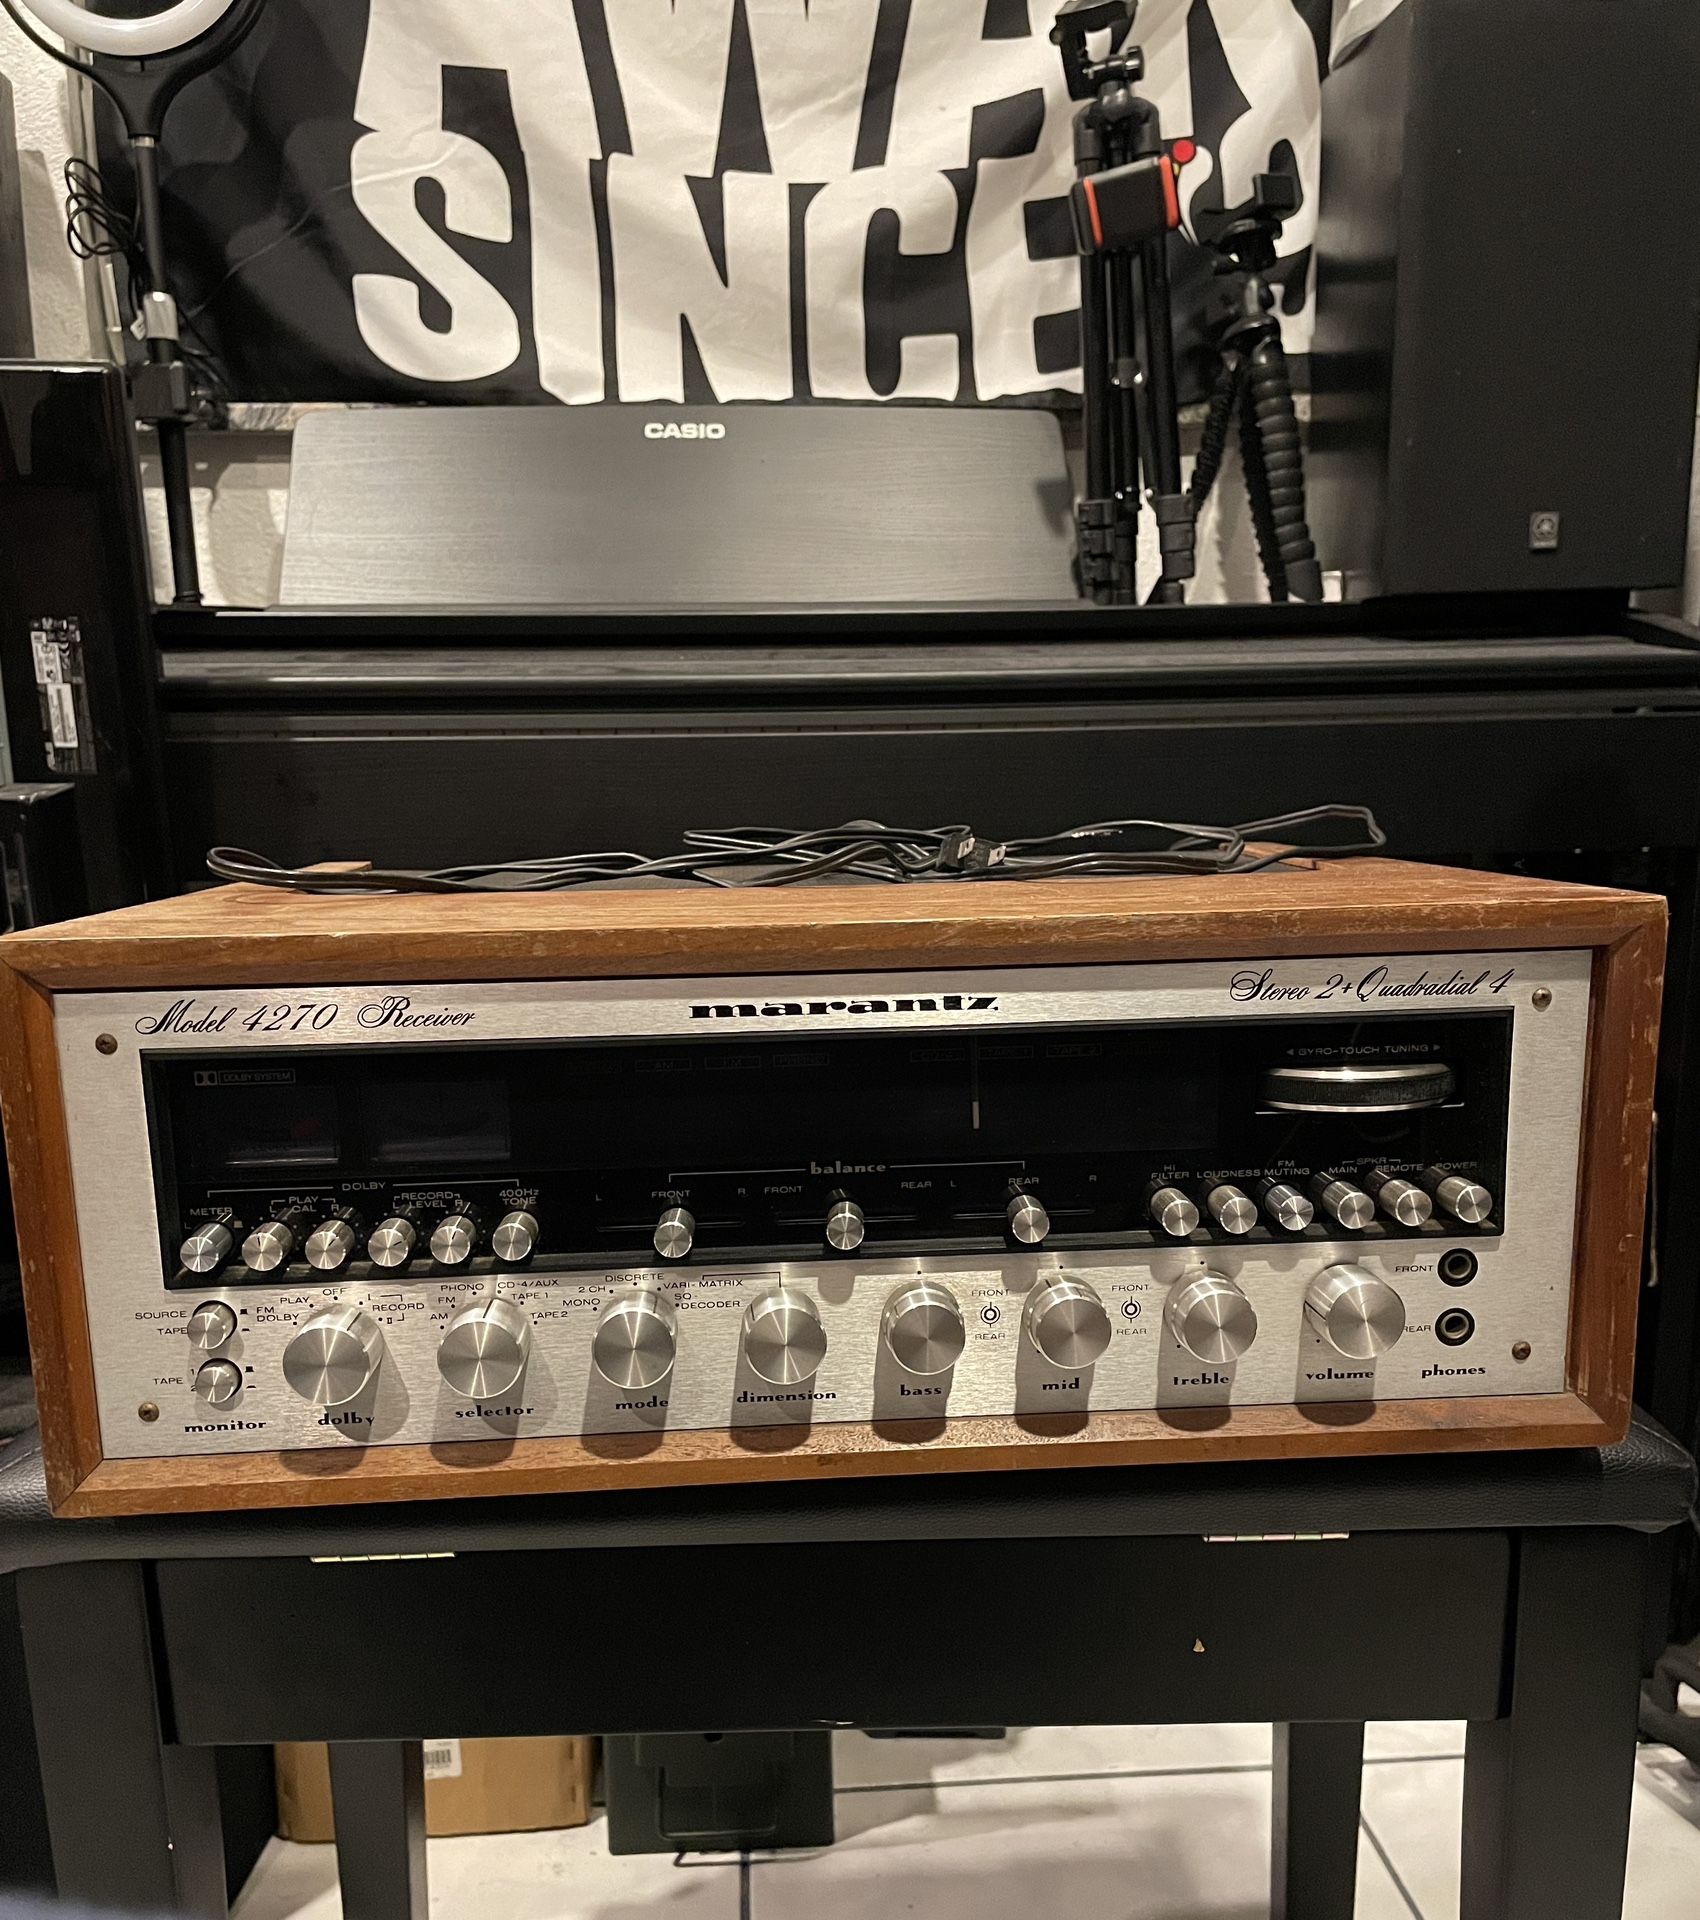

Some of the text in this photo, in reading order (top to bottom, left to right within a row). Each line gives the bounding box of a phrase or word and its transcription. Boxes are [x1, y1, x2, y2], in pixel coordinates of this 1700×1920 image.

[350, 128, 1088, 406] SINCE
[643, 422, 727, 441] CASIO
[1229, 968, 1312, 1002] Stereo
[688, 994, 1000, 1019] marantz
[134, 995, 477, 1036] Model 4270 Receiver
[1298, 1043, 1429, 1057] GYRO-TOUCH TUNING
[1277, 1159, 1295, 1168] FM
[1356, 1156, 1387, 1165] SPKR
[1435, 1160, 1478, 1171] POWER
[809, 1160, 887, 1176] balance
[1264, 1166, 1311, 1177] MUTING
[1328, 1165, 1358, 1174] MAIN
[1375, 1162, 1424, 1174] REMOTE
[1089, 1174, 1098, 1183] R
[1151, 1171, 1190, 1180] FILTER
[1196, 1168, 1261, 1179] LOUDNESS
[901, 1180, 932, 1190] REAR
[950, 1180, 957, 1189] L
[1008, 1176, 1040, 1186] REAR
[341, 1181, 388, 1192] DOLBY
[737, 1186, 747, 1196] R
[764, 1184, 804, 1195] FRONT
[401, 1191, 455, 1200] RECORD
[499, 1188, 540, 1197] 400Hz
[651, 1189, 691, 1200] FRONT
[288, 1195, 320, 1205] PLAY
[392, 1199, 463, 1210] L LEVEL R
[502, 1196, 537, 1206] TONE
[189, 1206, 233, 1217] METER
[269, 1203, 340, 1214] L CAL R
[1394, 1264, 1434, 1273] FRONT
[604, 1273, 665, 1283] DISCRETE
[440, 1282, 485, 1292] PHONO
[497, 1278, 560, 1290] CD-4/AUX
[1111, 1284, 1149, 1292] FRONT
[322, 1287, 348, 1296] OFF
[578, 1285, 606, 1294] 2 CH
[971, 1288, 1010, 1297] FRONT
[279, 1295, 310, 1305] PLAY
[438, 1296, 457, 1304] FM
[512, 1292, 542, 1301] TAPE
[372, 1302, 425, 1312] RECORD
[562, 1298, 601, 1307] MONO
[681, 1300, 741, 1310] DECODER
[135, 1310, 188, 1320] SOURCE
[256, 1306, 275, 1314] FM
[256, 1313, 300, 1323] DOLBY
[430, 1312, 449, 1320] AM
[157, 1327, 188, 1335] TAPE
[1116, 1327, 1147, 1336] REAR
[974, 1332, 1006, 1341] REAR
[1305, 1367, 1375, 1380] volume
[1421, 1363, 1487, 1379] phones
[153, 1377, 184, 1385] TAPE
[1042, 1376, 1080, 1391] mid
[1173, 1372, 1230, 1386] treble
[899, 1384, 942, 1397] bass
[736, 1389, 837, 1404] dimension
[615, 1395, 669, 1410] mode
[455, 1404, 535, 1418] selector
[317, 1411, 375, 1427] dolby
[184, 1419, 267, 1433] monitor
